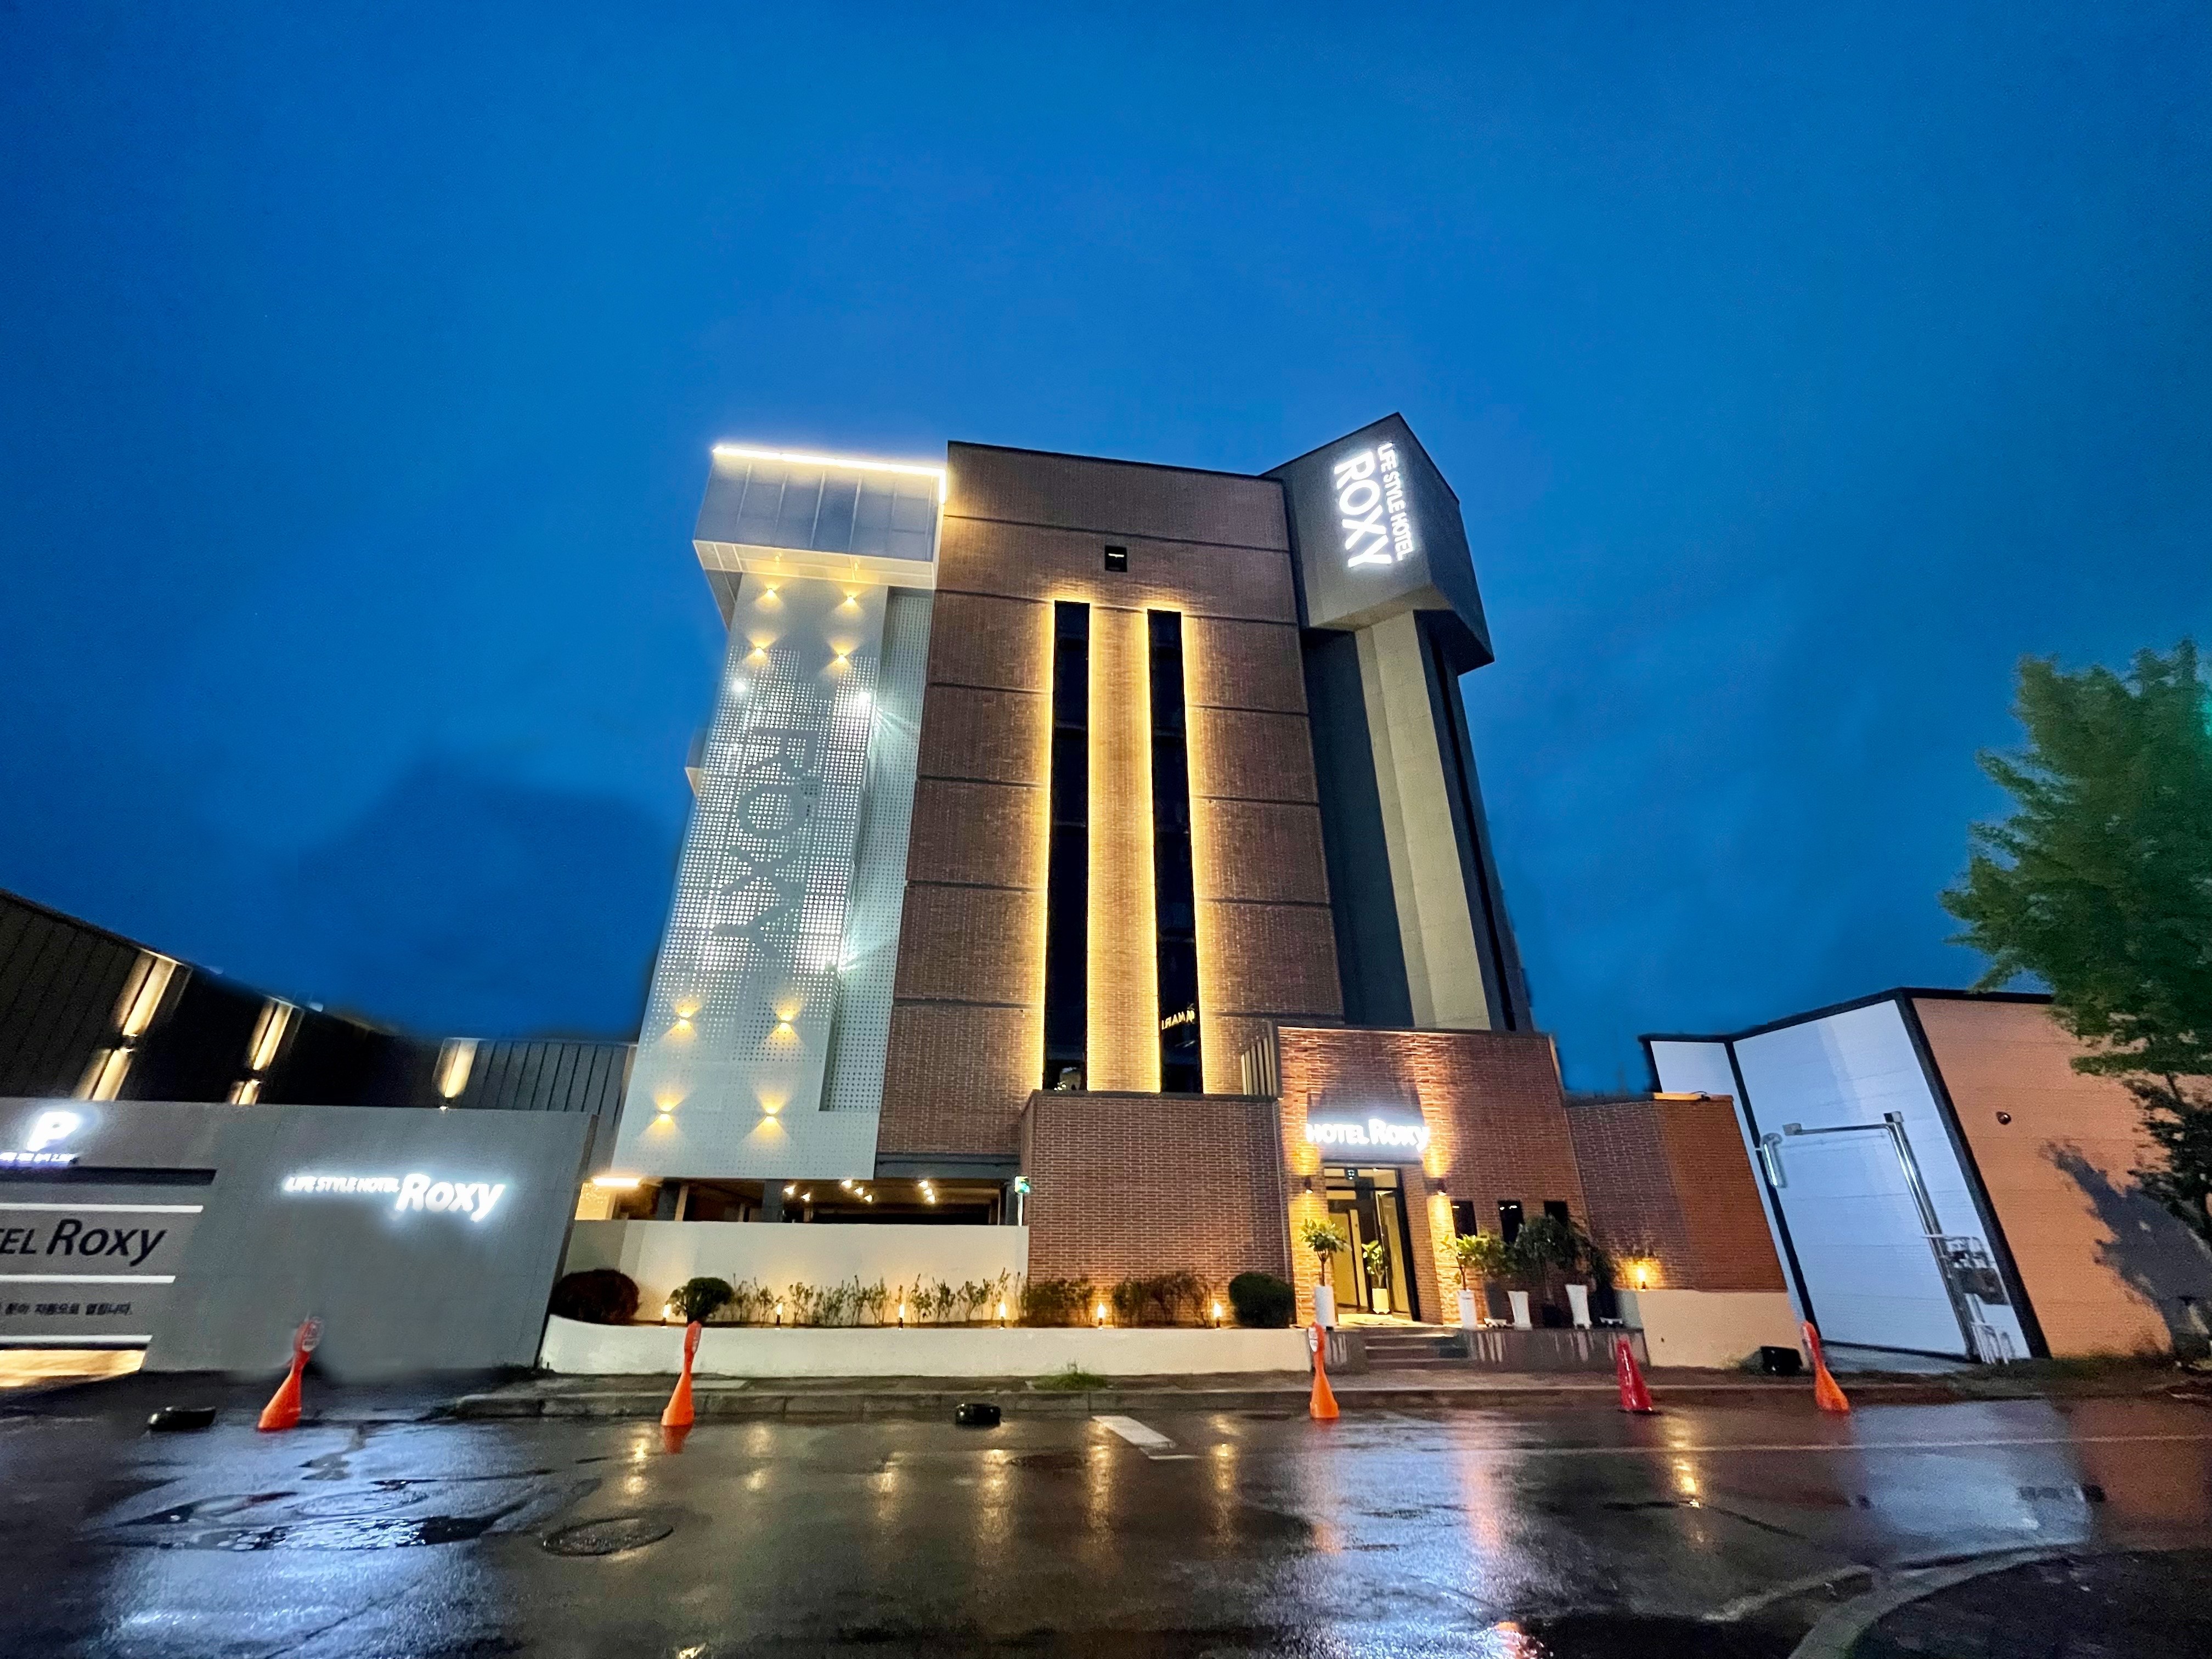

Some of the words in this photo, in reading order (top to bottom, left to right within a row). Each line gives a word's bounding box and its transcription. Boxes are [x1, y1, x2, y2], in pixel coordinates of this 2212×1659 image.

[1378, 442, 1397, 473] LIFE
[1334, 451, 1392, 568] ROXY
[1383, 471, 1406, 514] STYLE
[1390, 512, 1414, 562] HOTEL
[712, 727, 821, 963] ROXY
[26, 1111, 81, 1152] P
[1306, 1124, 1370, 1145] HOTEL
[1368, 1118, 1431, 1153] Roxy
[396, 1174, 506, 1222] Roxy
[46, 1218, 167, 1267] Roxy
